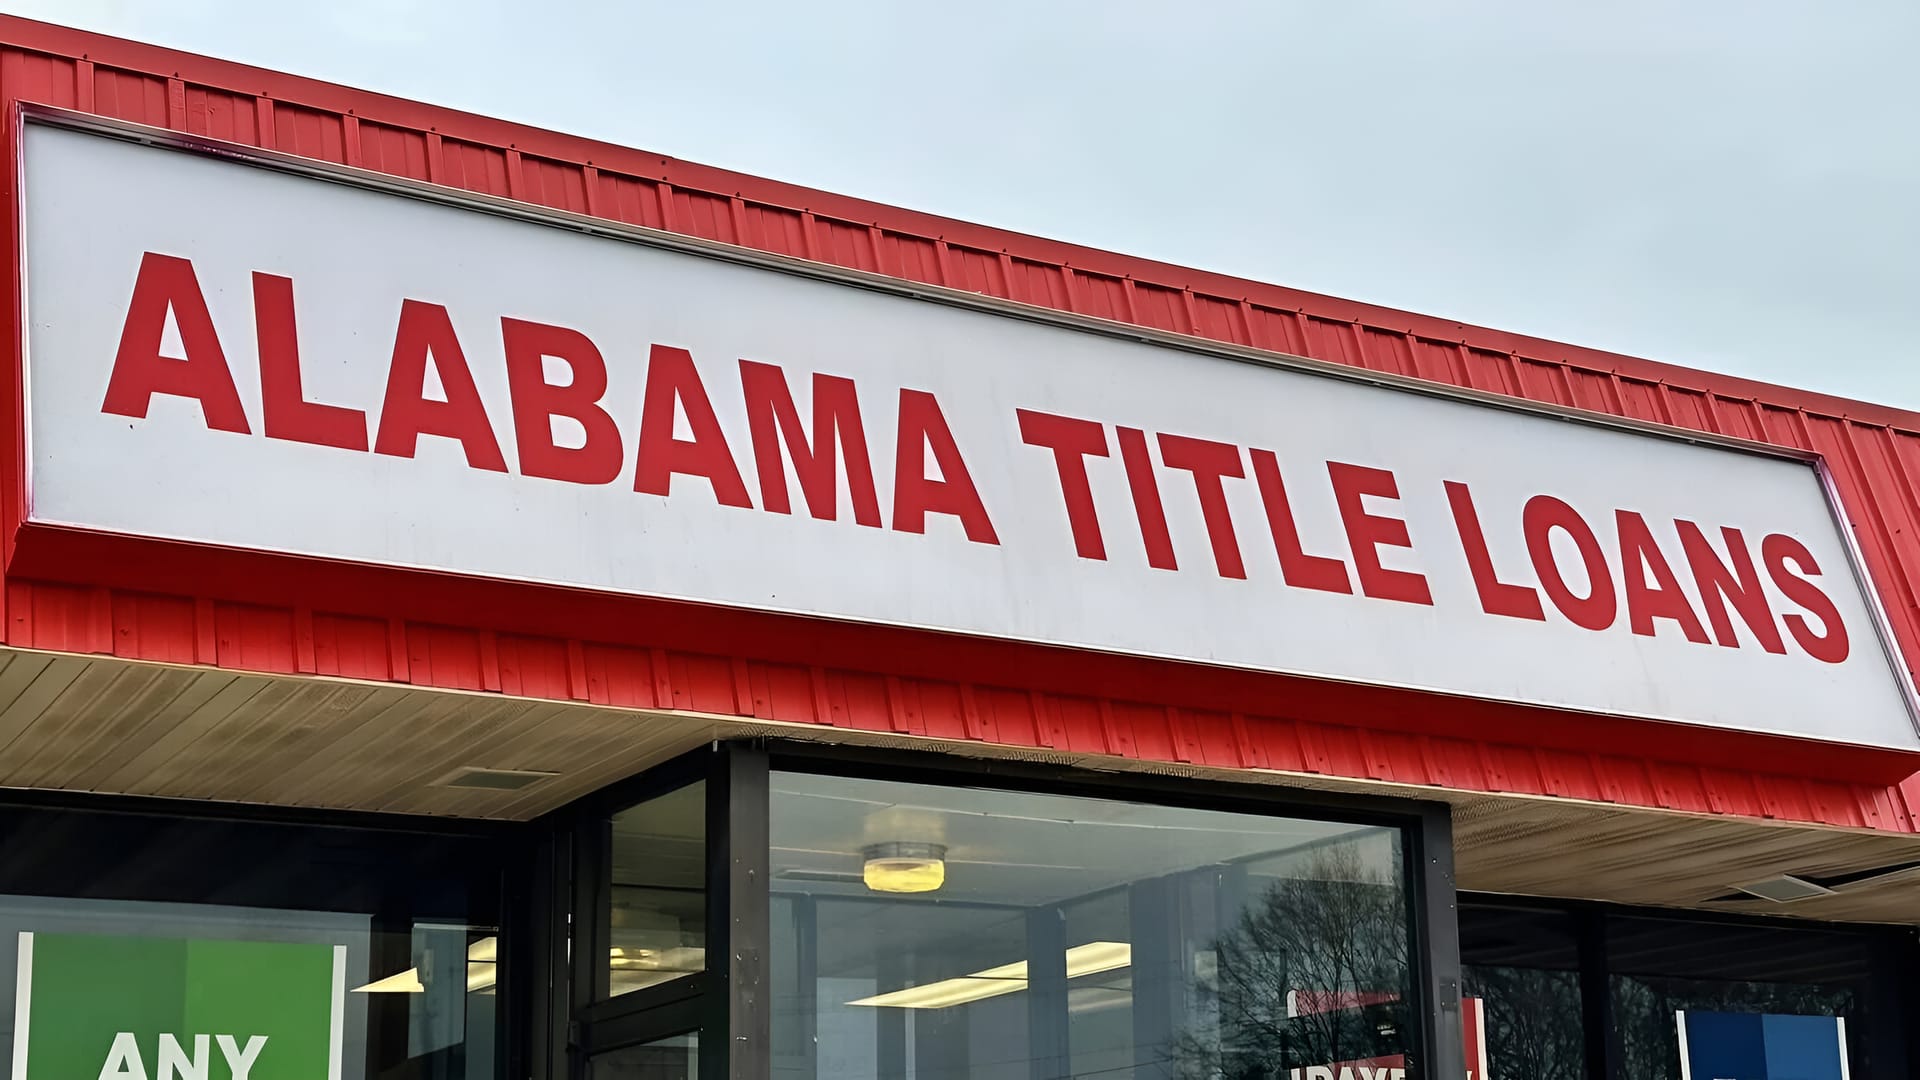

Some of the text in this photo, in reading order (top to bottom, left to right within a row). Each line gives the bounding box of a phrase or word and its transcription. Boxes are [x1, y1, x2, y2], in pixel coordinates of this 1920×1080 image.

[102, 252, 1850, 664] ALABAMA TITLE LOANS
[98, 1032, 269, 1080] ANY
